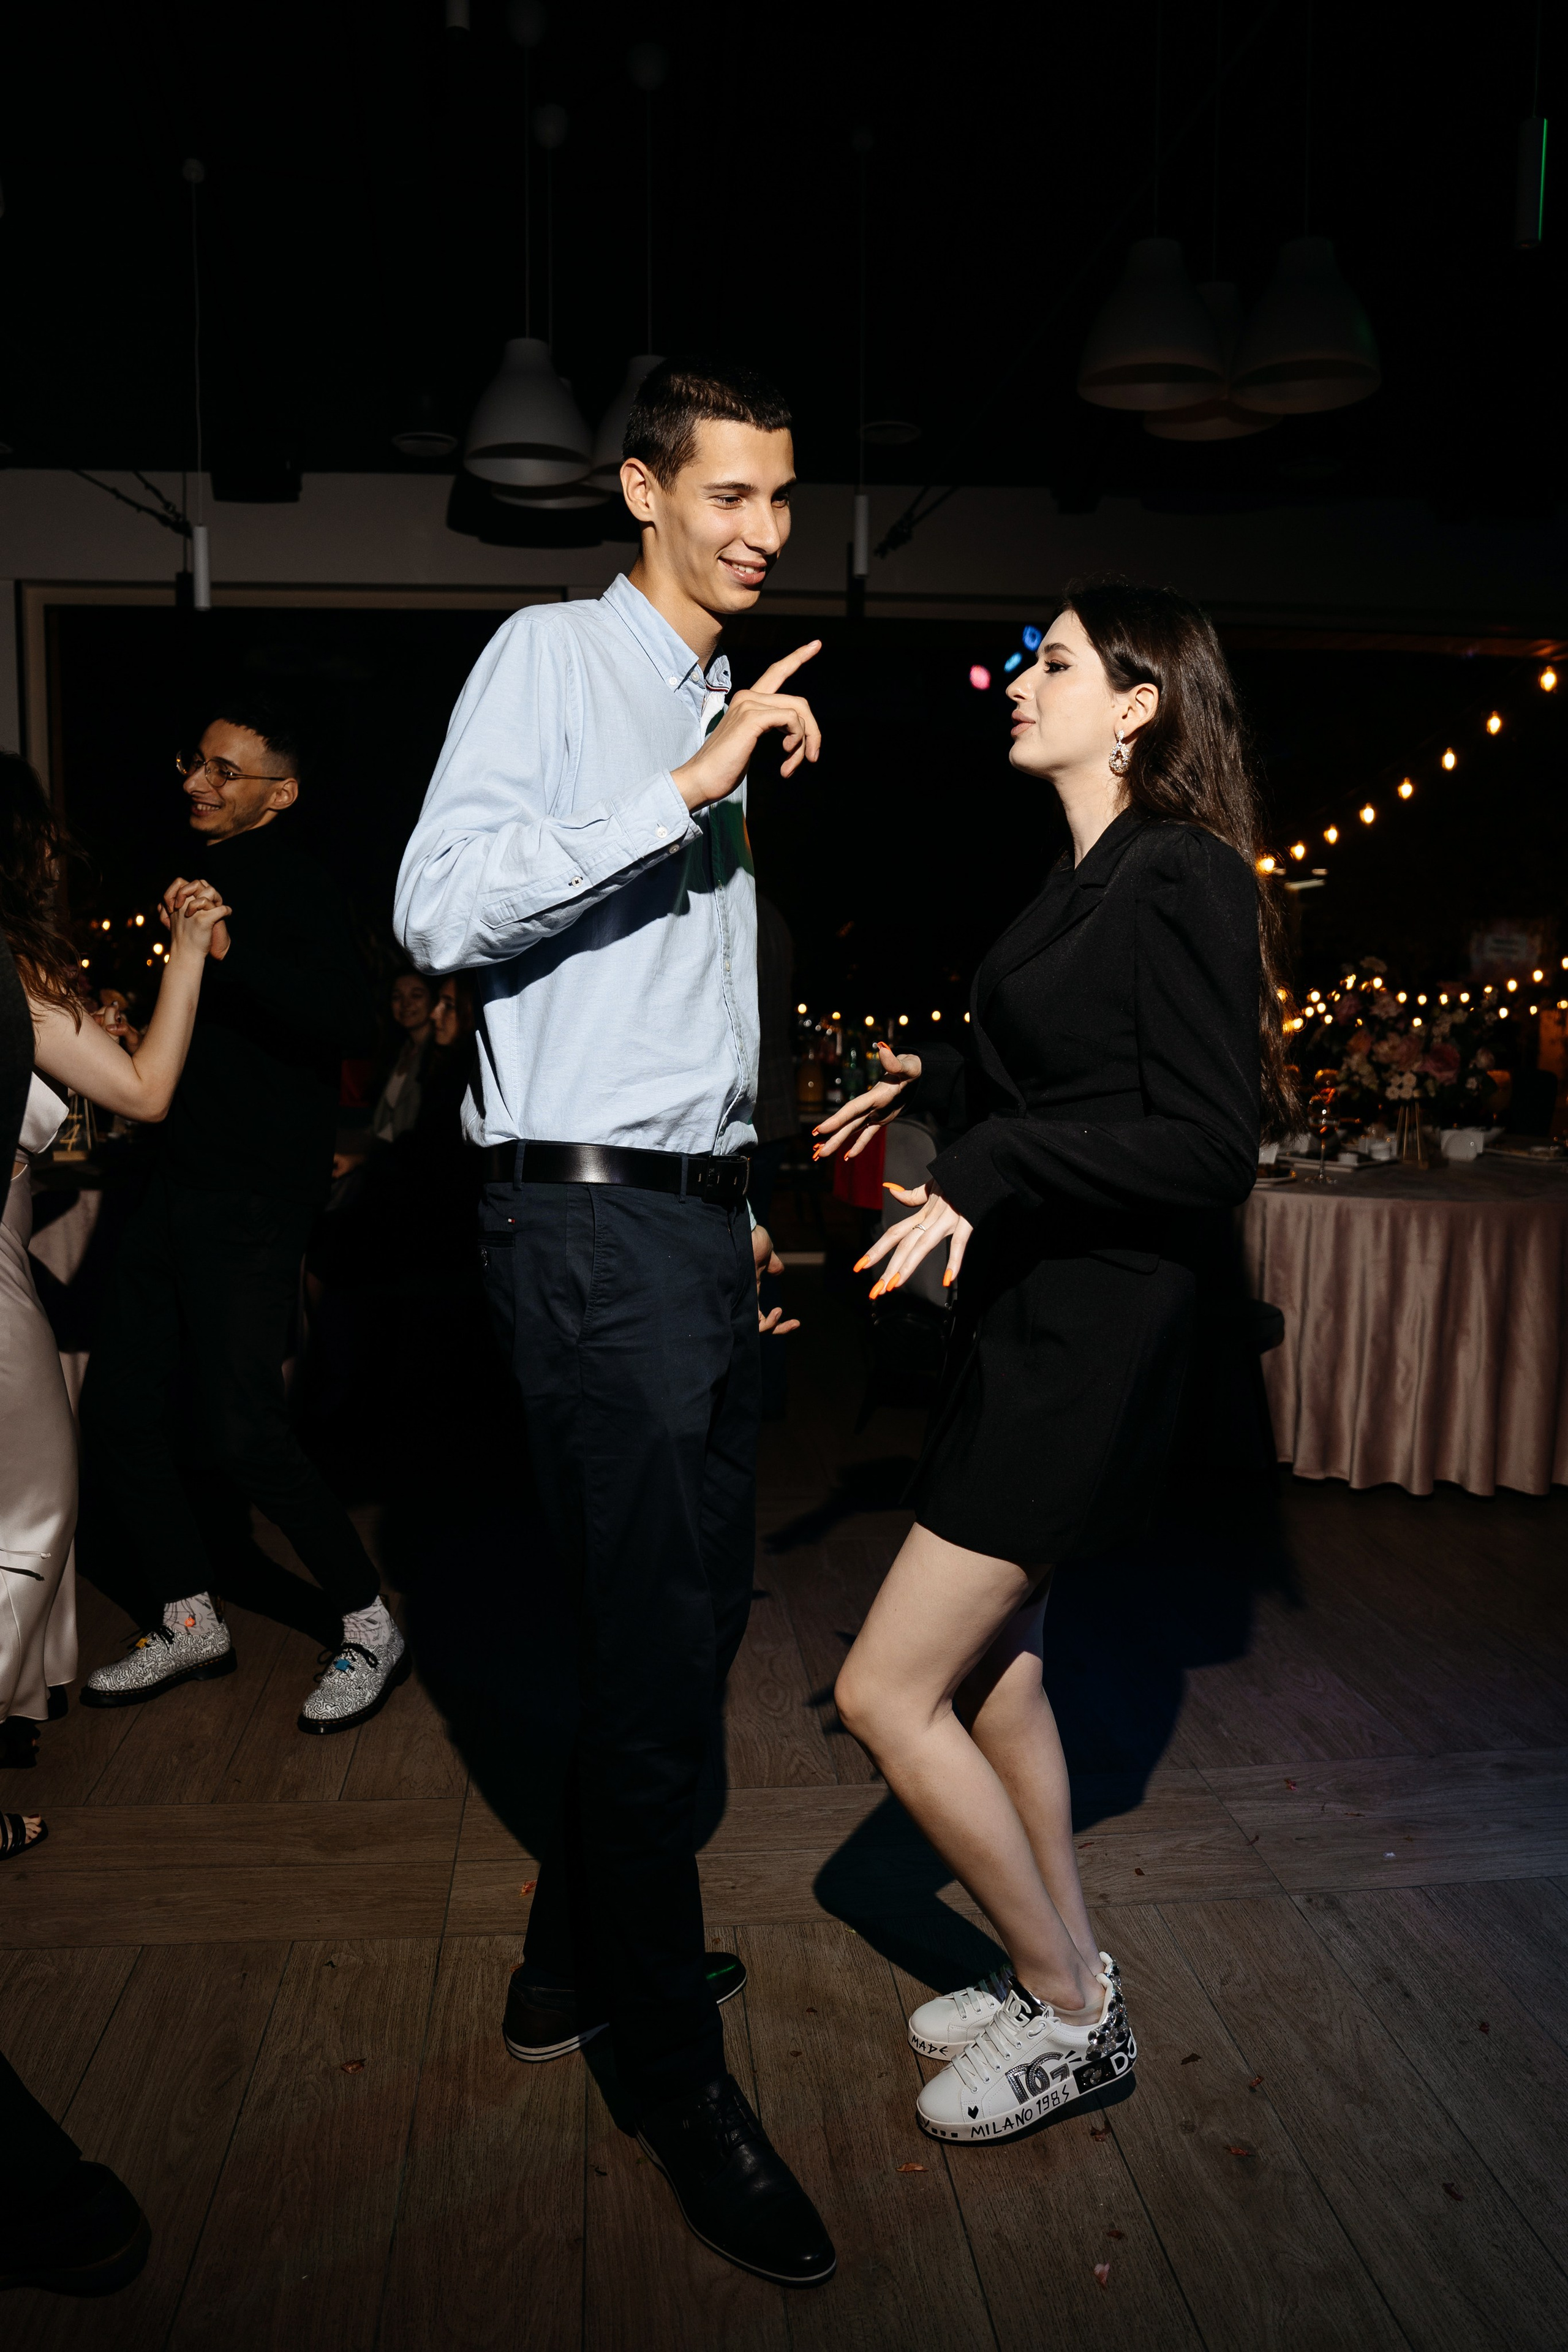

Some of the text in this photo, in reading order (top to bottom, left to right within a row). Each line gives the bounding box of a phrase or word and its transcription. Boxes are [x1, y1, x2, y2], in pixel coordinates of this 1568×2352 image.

[59, 1123, 81, 1152] 4
[911, 2035, 949, 2057] MADE
[971, 2108, 1033, 2138] MILANO
